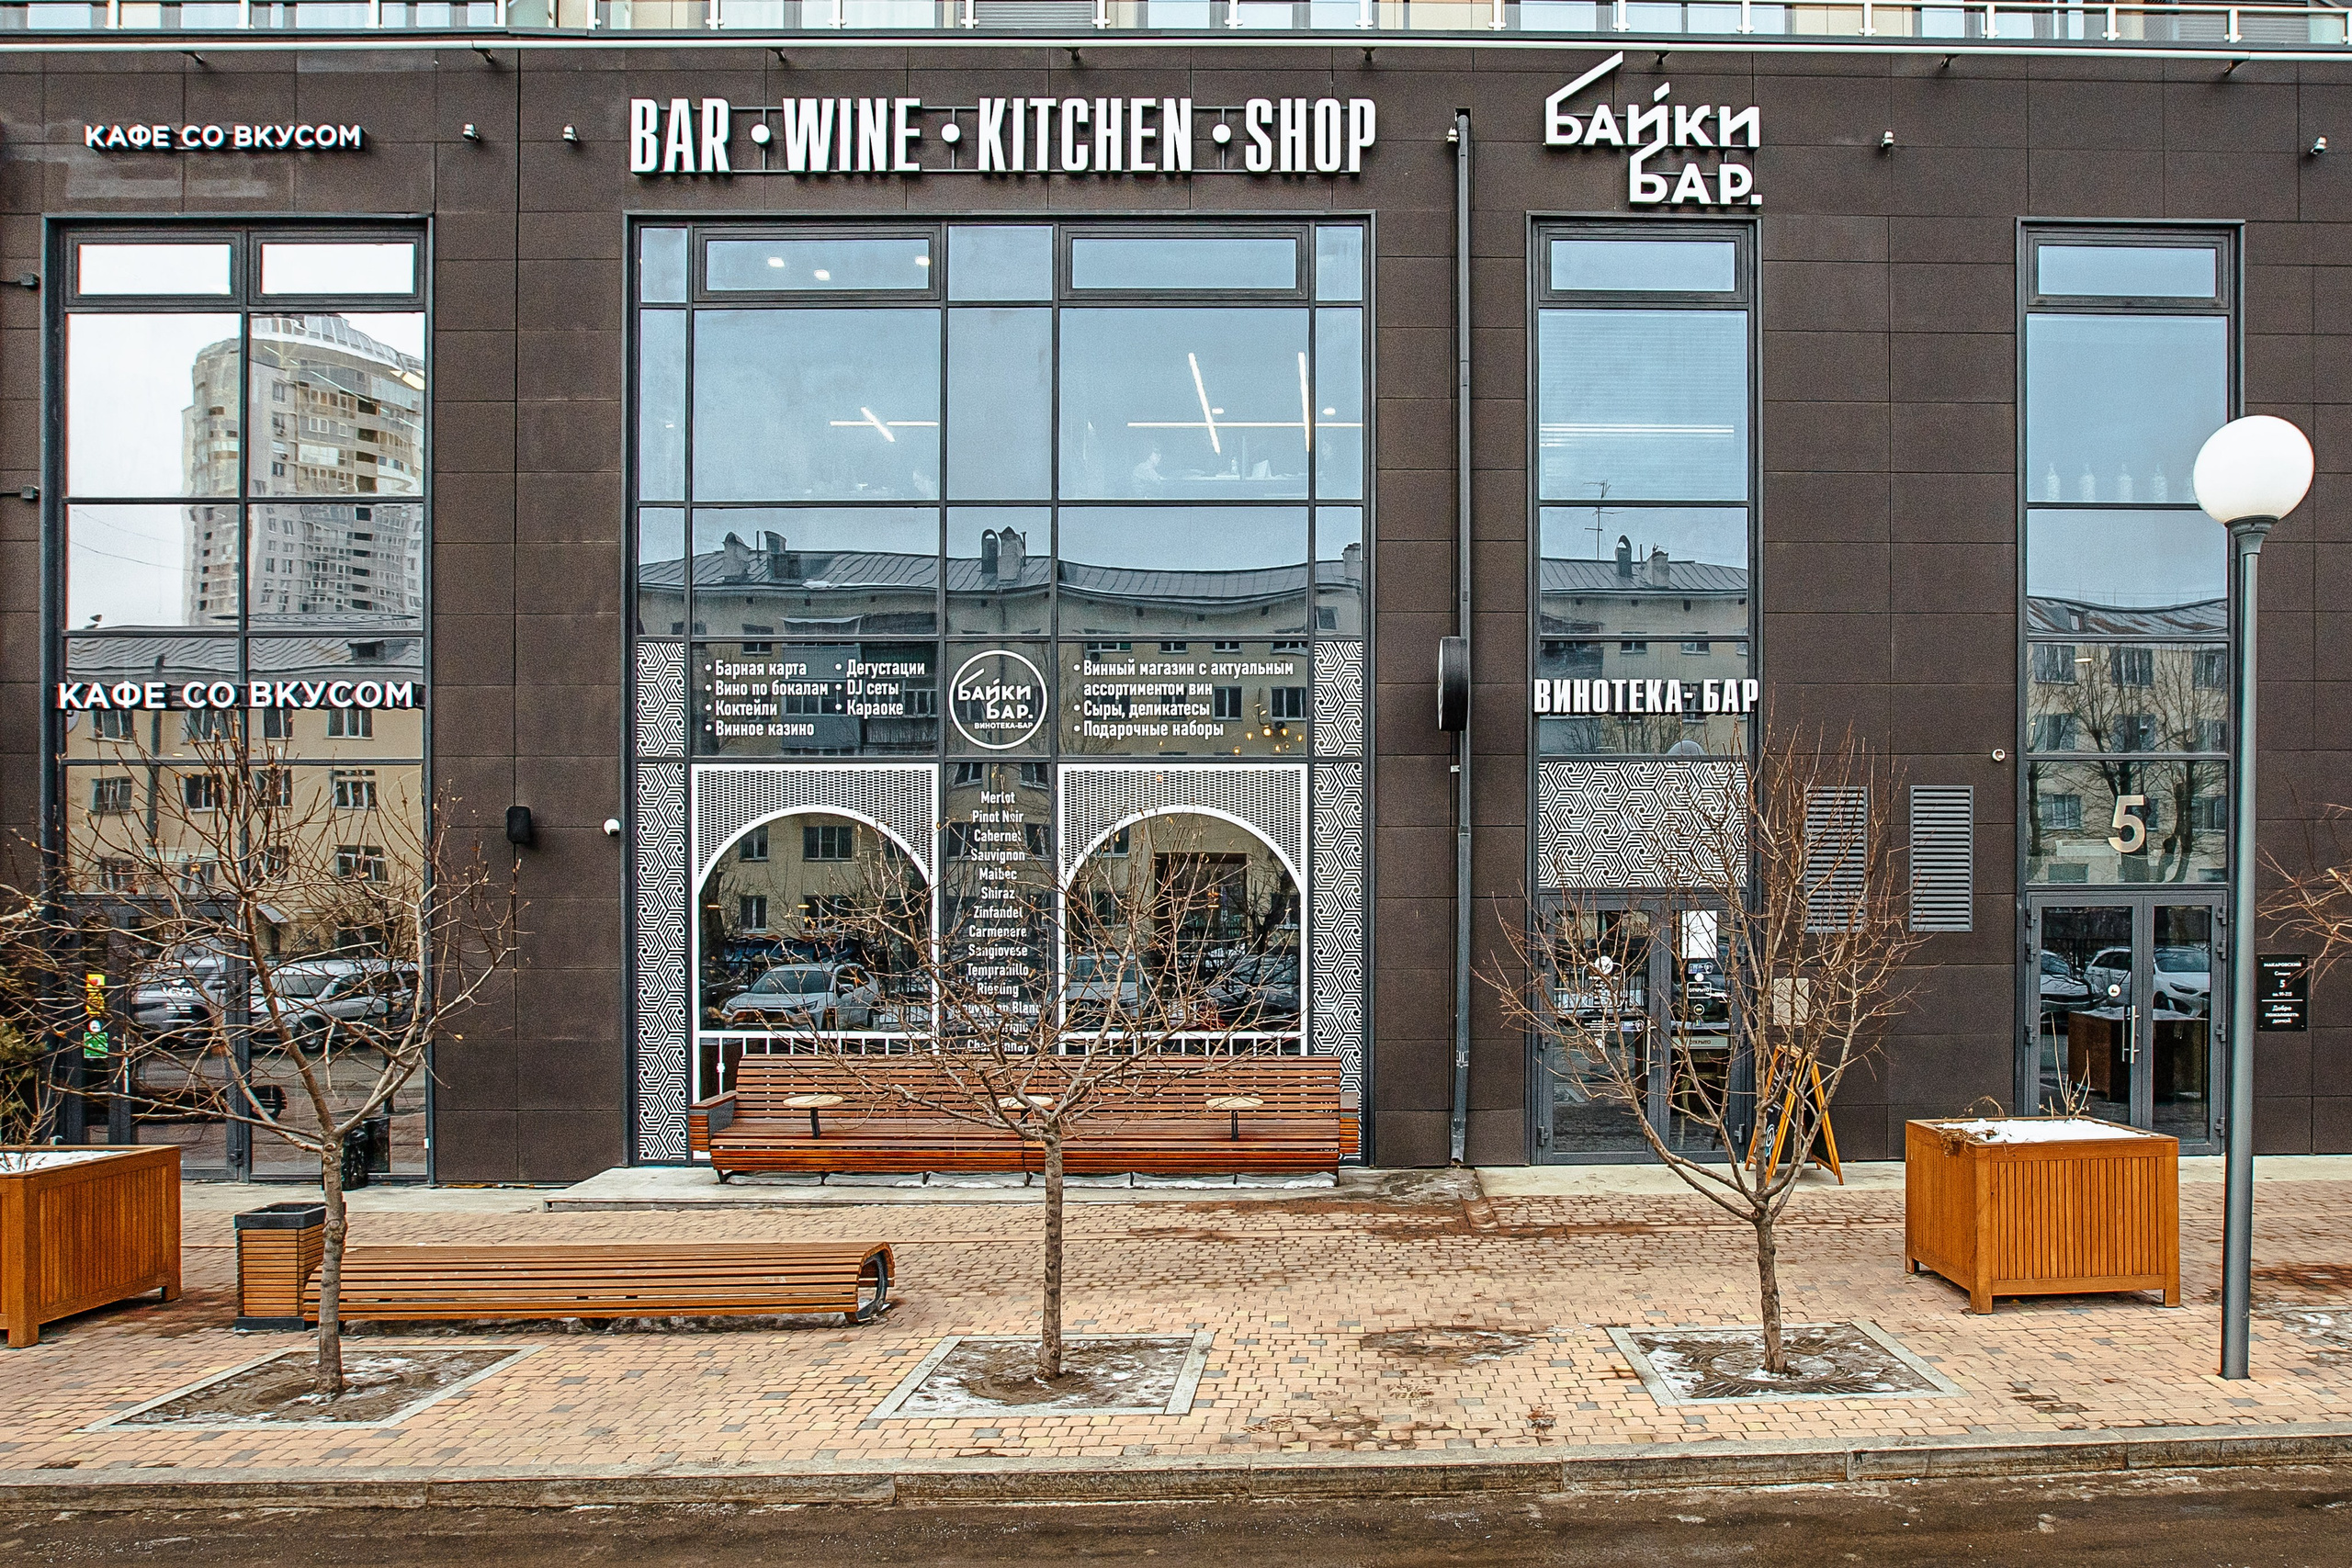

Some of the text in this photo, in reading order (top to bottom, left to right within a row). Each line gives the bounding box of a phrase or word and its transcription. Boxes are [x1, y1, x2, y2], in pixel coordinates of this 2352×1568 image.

[1545, 51, 1760, 148] БАЙКИ
[85, 125, 363, 148] КАФЕ СО ВКУСОМ
[629, 97, 1376, 175] BAR WINE KITCHEN SHOP
[715, 660, 807, 678] Барная карта
[847, 660, 925, 678] Дегустации
[1083, 659, 1294, 679] Винный магазин с актуальным
[715, 680, 828, 696] Вино по бокалам
[847, 680, 899, 695] DJ сеты
[958, 668, 1031, 700] БАЙКИ
[1083, 682, 1213, 699] ассортиментом вин
[58, 681, 413, 708] КАФЕ СО ВКУСОМ
[715, 698, 778, 716] Коктейли
[847, 700, 904, 718] Караоке
[1083, 701, 1210, 719] Сыры, деликатесы
[715, 720, 815, 737] Винное казино
[974, 721, 1034, 729] ВИНОТЕКА-БАР
[1083, 720, 1224, 739] Подарочные наборы
[980, 791, 1015, 804] Merlot
[972, 809, 1000, 823] Pinot
[2108, 795, 2146, 852] 5
[971, 849, 1025, 863] Sauvignon
[978, 867, 1018, 880] Malbec
[980, 886, 1015, 899] Shiraz
[973, 906, 1023, 919] Zinfandel
[2278, 979, 2286, 988] 5
